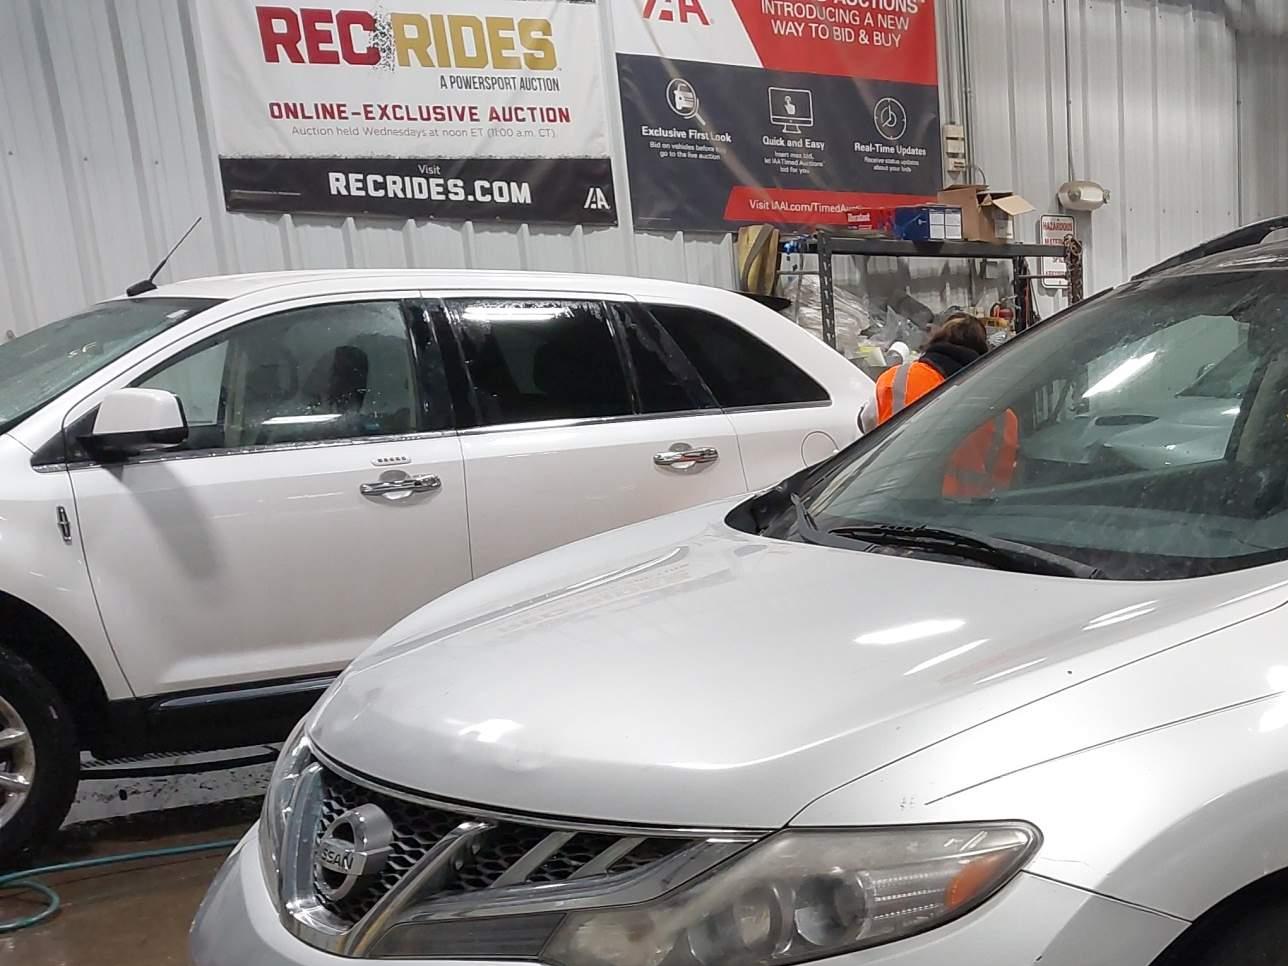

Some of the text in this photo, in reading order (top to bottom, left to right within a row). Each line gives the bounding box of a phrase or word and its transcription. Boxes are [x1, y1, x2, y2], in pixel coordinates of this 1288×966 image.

[761, 0, 909, 31] INTRODUCING A NEW
[771, 19, 901, 48] WAY TO BID & BUY
[391, 13, 558, 71] RIDES
[440, 75, 560, 92] A POWERSPORT AUCTION
[270, 102, 571, 123] ONLINE-EXCLUSIVE AUCTION
[291, 126, 335, 136] Auction
[336, 126, 360, 136] held
[362, 127, 428, 138] Wednesdays
[442, 129, 468, 137] noon
[641, 126, 687, 139] Exclusive
[688, 129, 710, 141] First
[763, 136, 825, 150] Quick and Easy
[854, 143, 927, 156] Real-Time Updates
[418, 164, 441, 176] Visit
[328, 171, 532, 205] RECRIDES.COM
[749, 199, 770, 210] Visit
